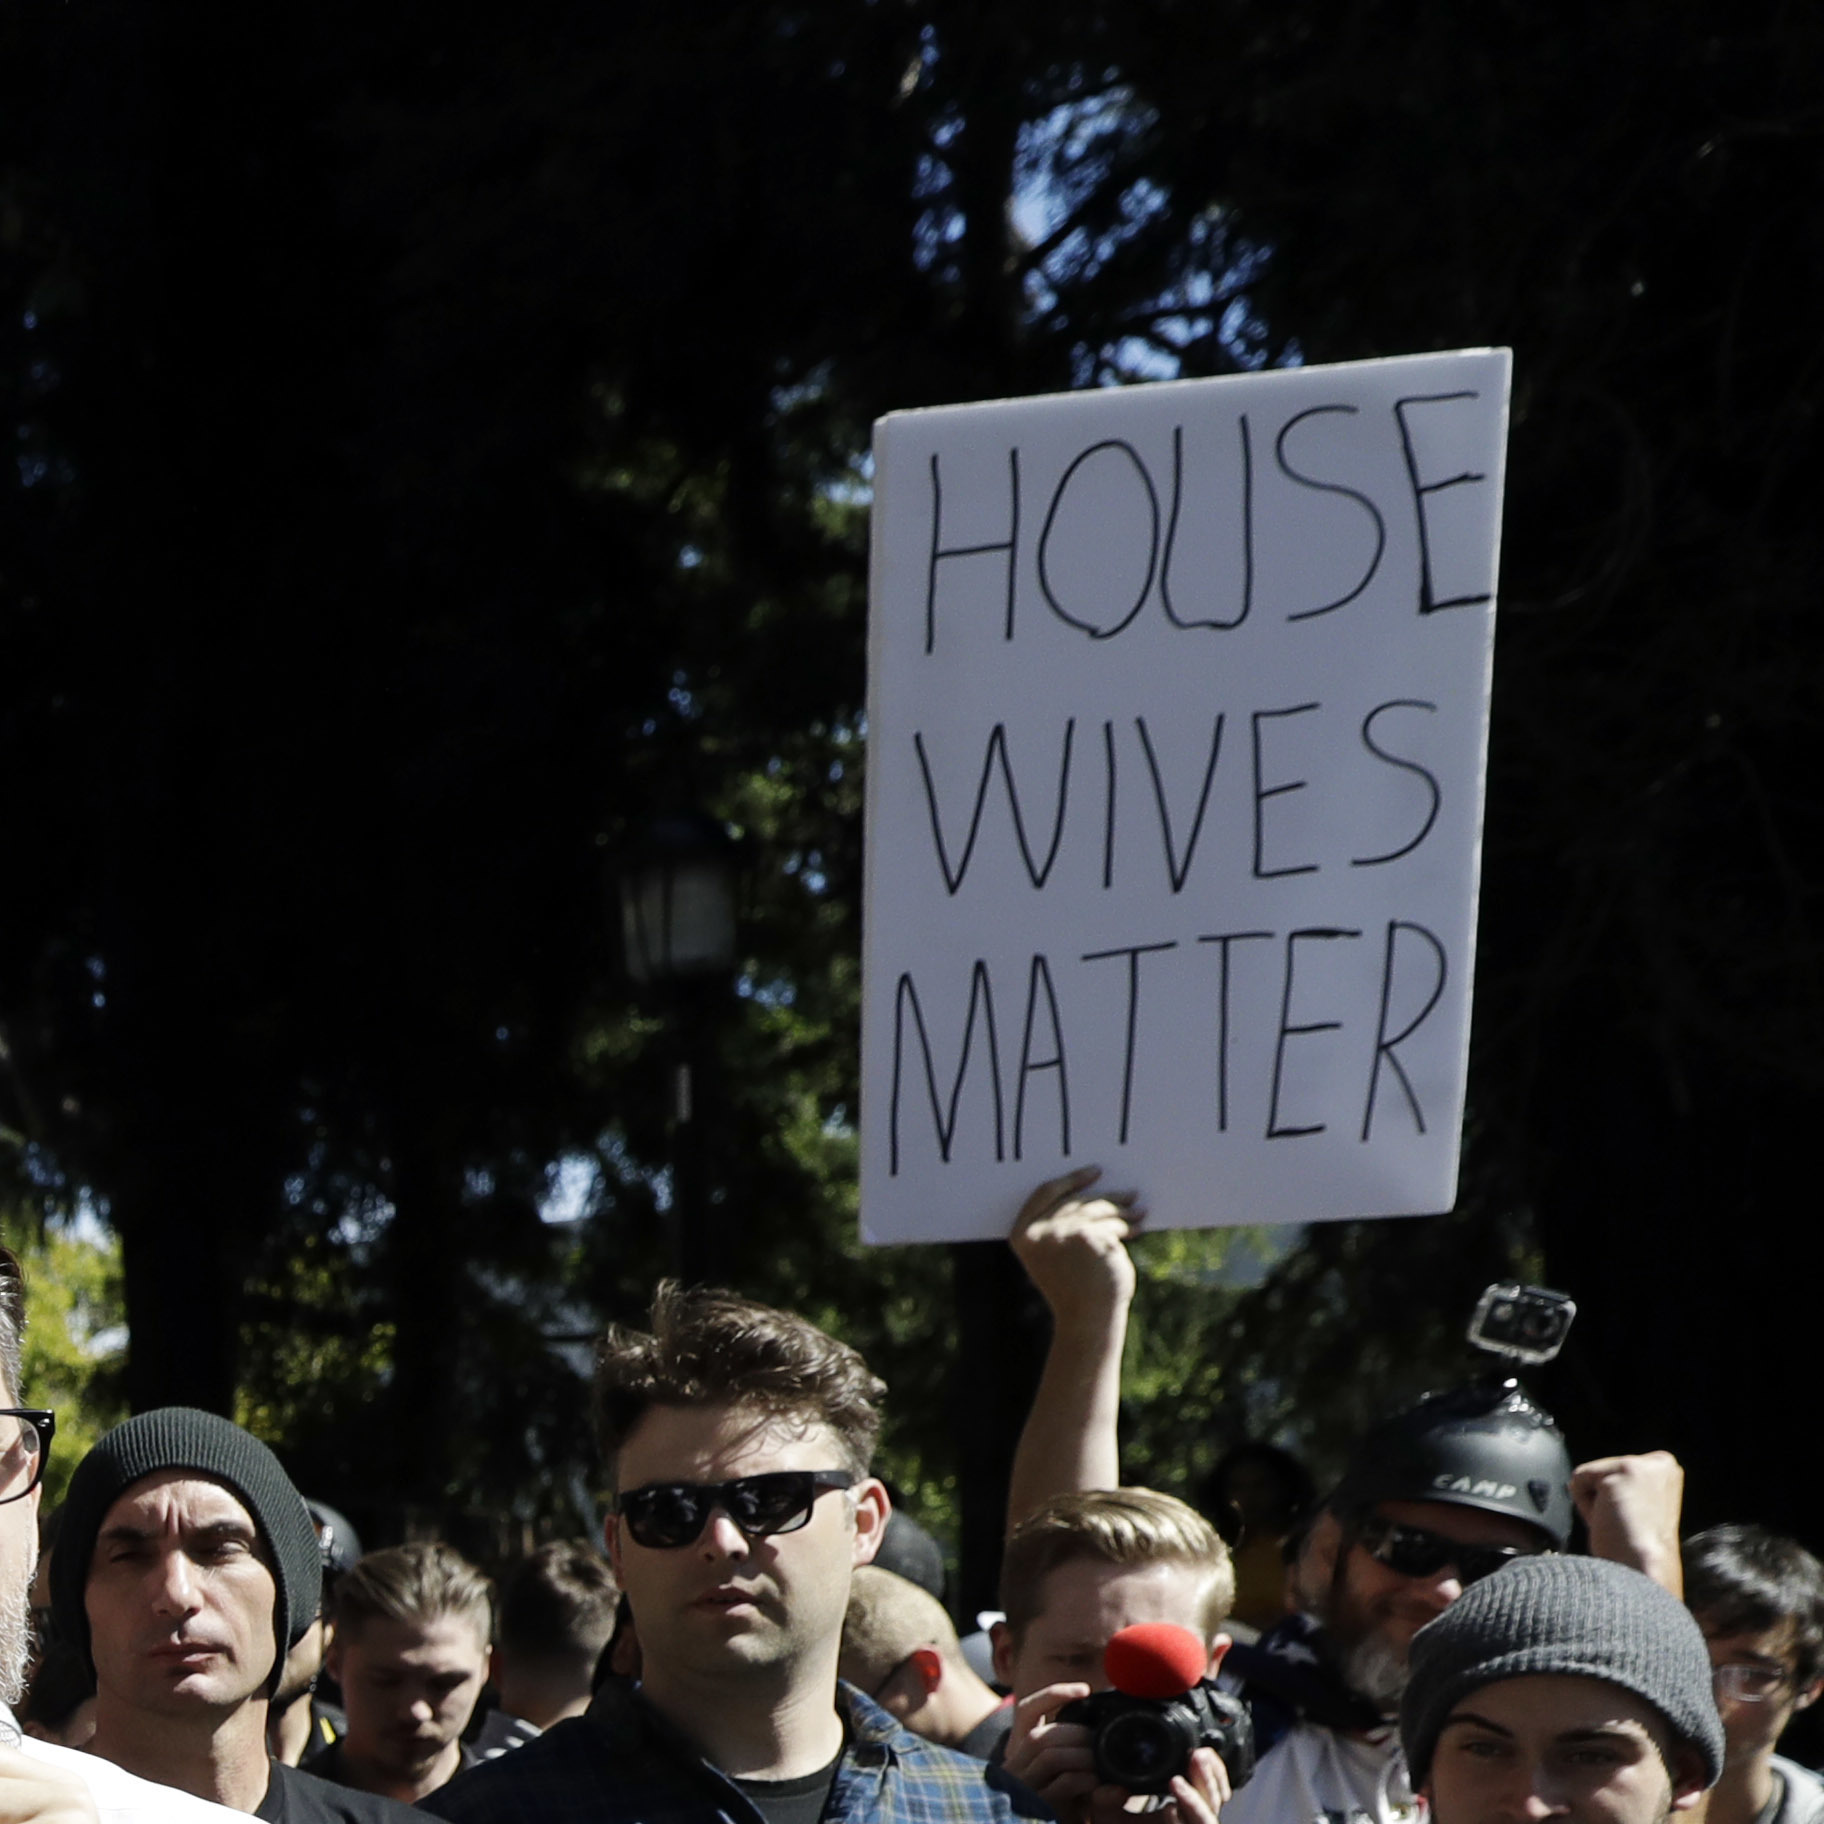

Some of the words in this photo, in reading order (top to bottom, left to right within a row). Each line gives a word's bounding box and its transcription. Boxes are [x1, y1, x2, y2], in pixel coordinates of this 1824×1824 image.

[926, 391, 1494, 656] HOUSE
[914, 699, 1442, 896] WIVES
[889, 920, 1448, 1177] MATTER
[1432, 1473, 1517, 1500] CAMP
